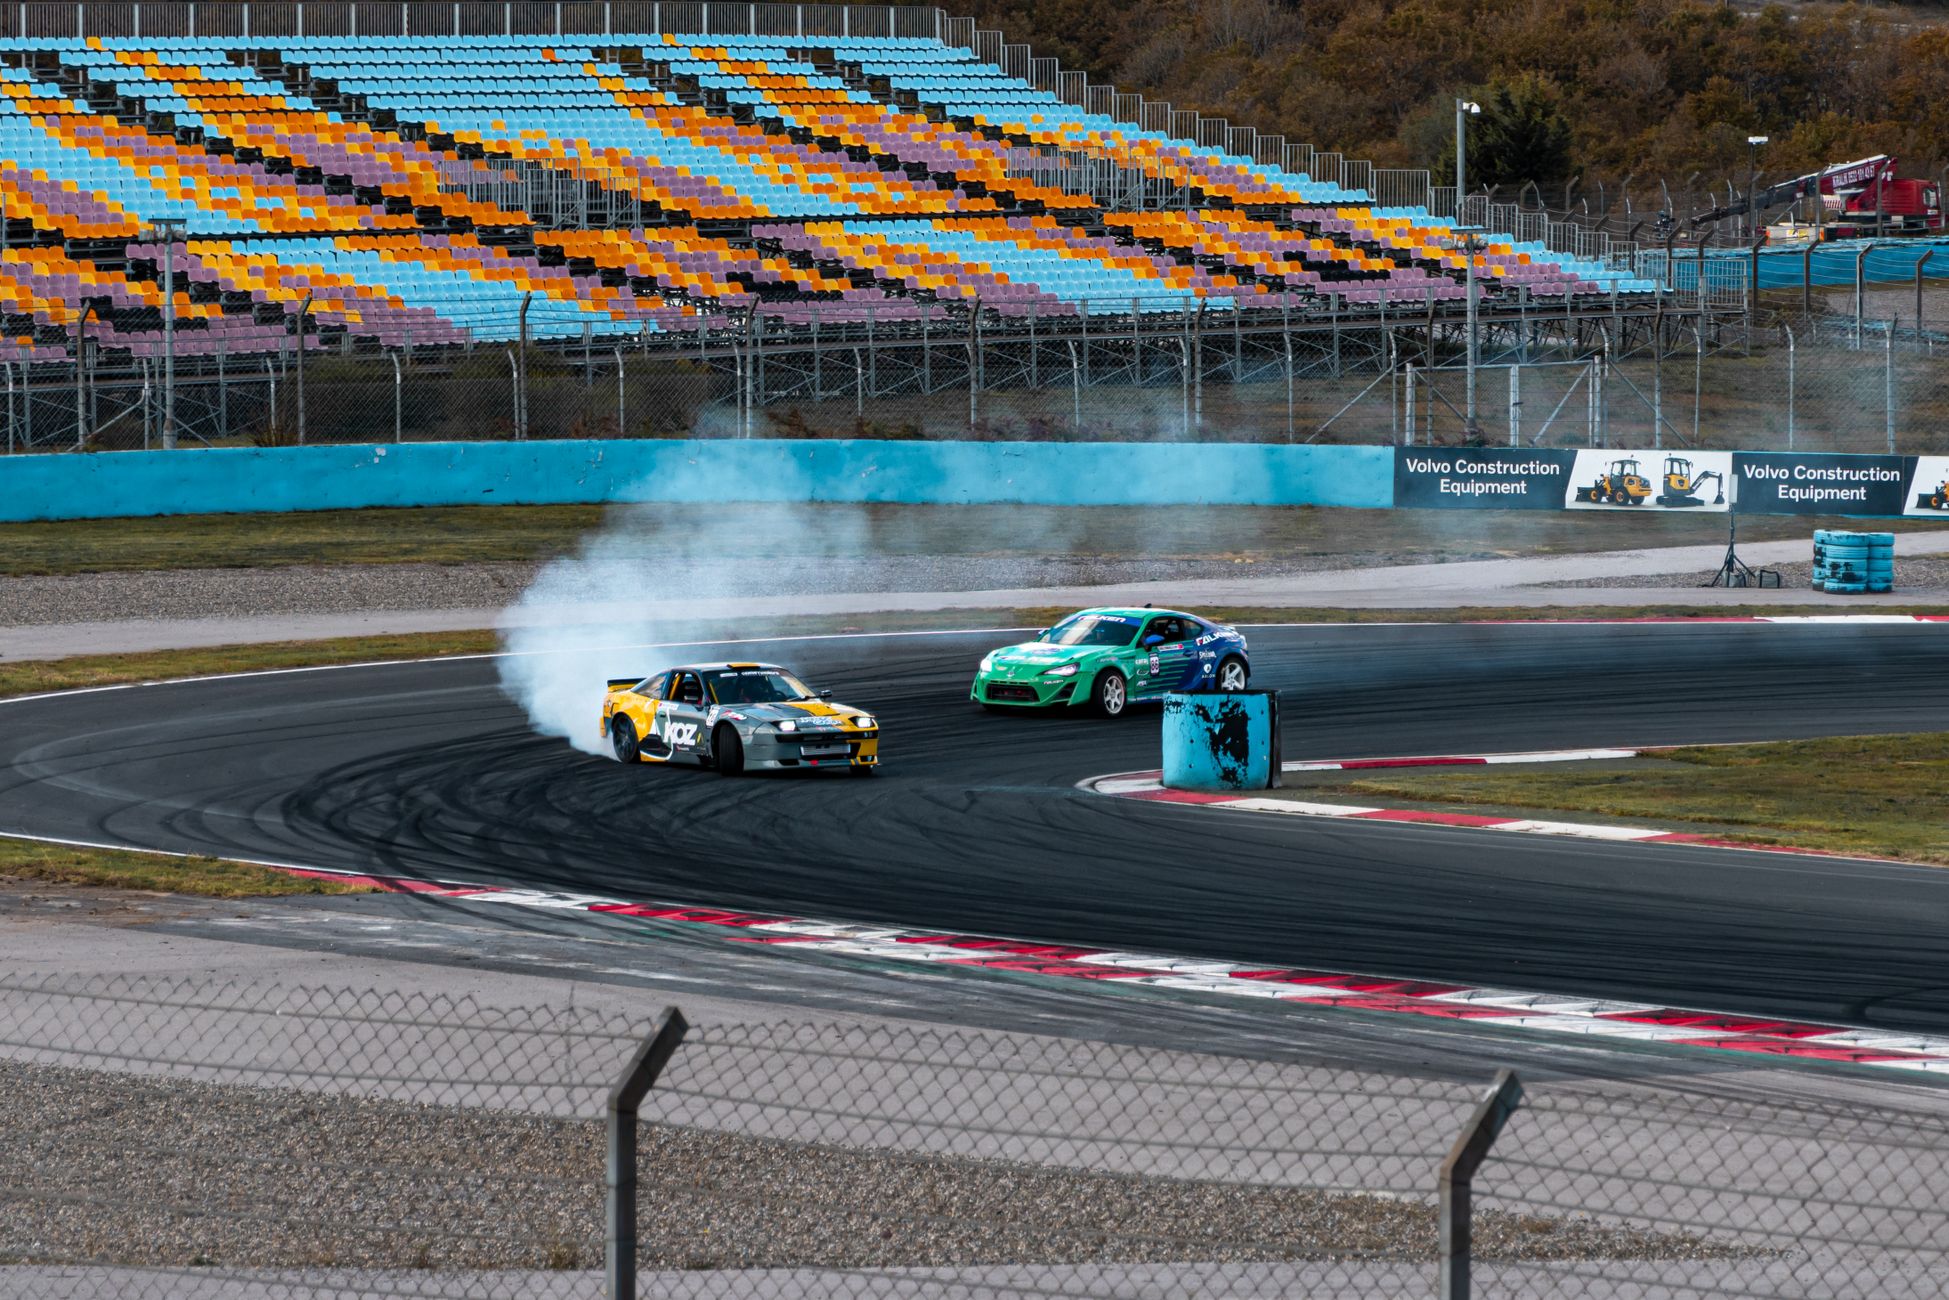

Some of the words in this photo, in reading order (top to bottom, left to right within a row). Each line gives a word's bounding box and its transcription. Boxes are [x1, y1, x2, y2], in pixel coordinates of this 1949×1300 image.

[1406, 458, 1451, 474] Volvo
[1455, 459, 1561, 475] Construction
[1744, 464, 1789, 479] Volvo
[1794, 465, 1901, 482] Construction
[1440, 479, 1527, 497] Equipment
[1778, 485, 1867, 503] Equipment
[1195, 631, 1234, 647] FALK
[663, 722, 698, 745] KOZ
